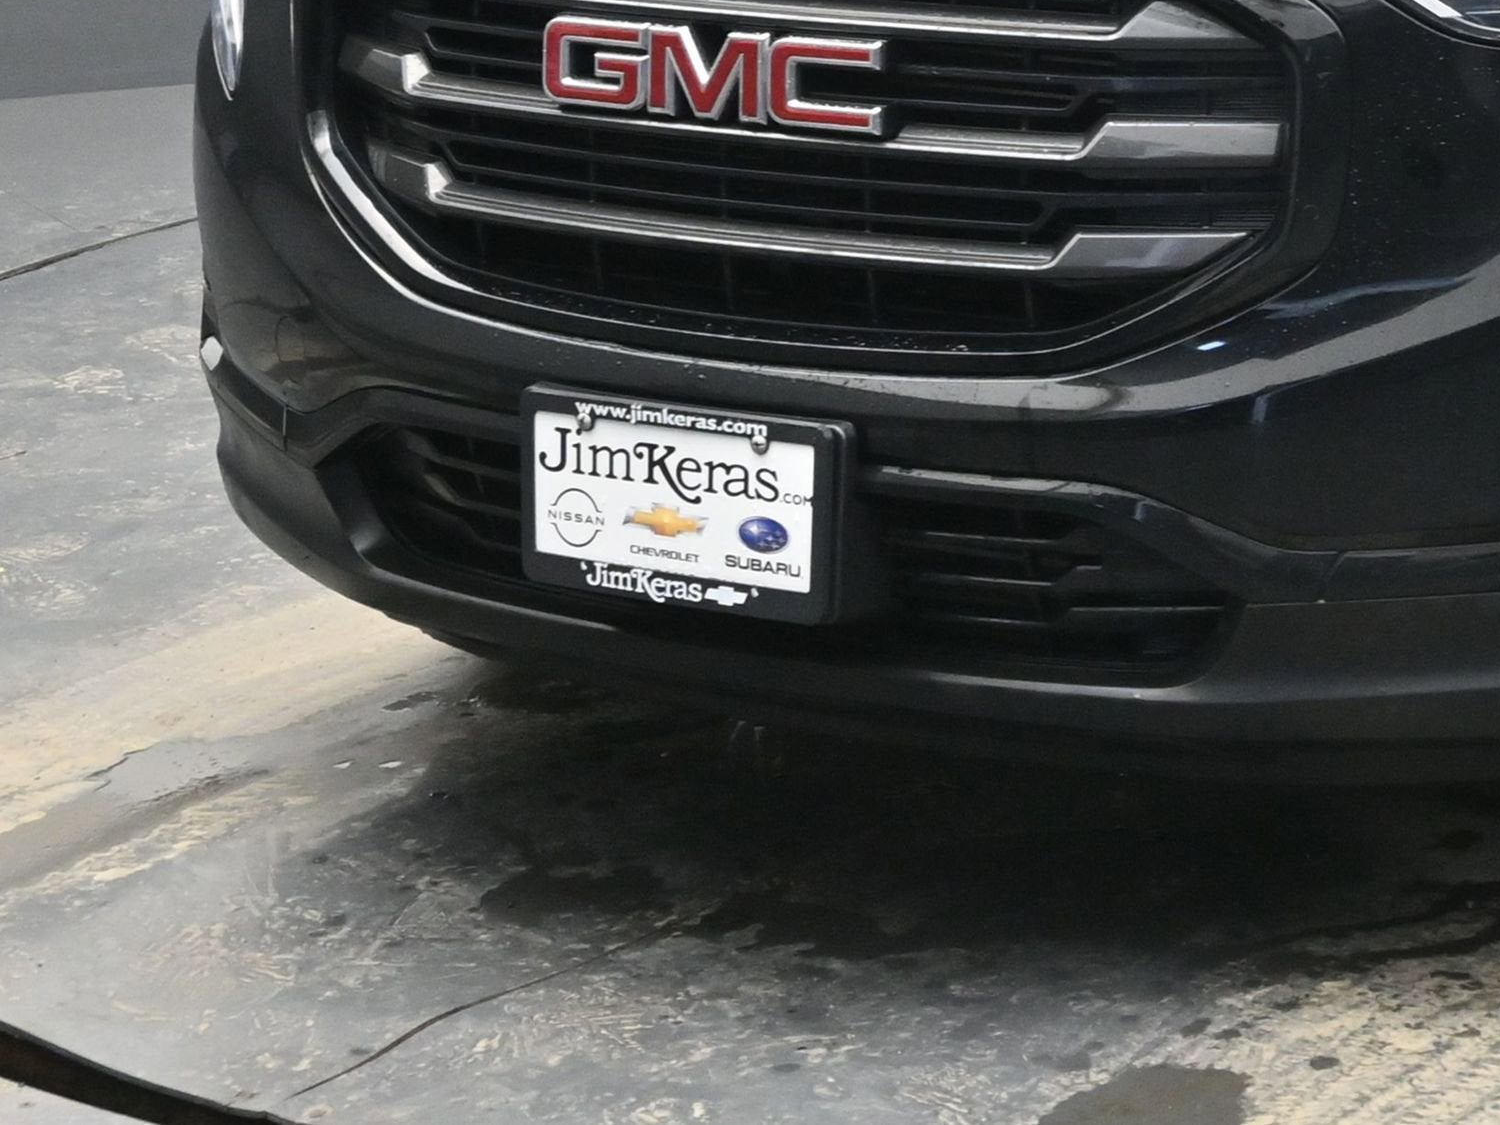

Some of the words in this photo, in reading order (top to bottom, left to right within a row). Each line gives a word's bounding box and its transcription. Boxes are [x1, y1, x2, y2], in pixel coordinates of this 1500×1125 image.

[542, 13, 882, 135] GMC
[575, 400, 768, 437] www.jimkeras.com
[547, 508, 605, 526] NISSAN
[629, 544, 699, 564] CHEVROLET
[724, 554, 801, 577] SUBARU
